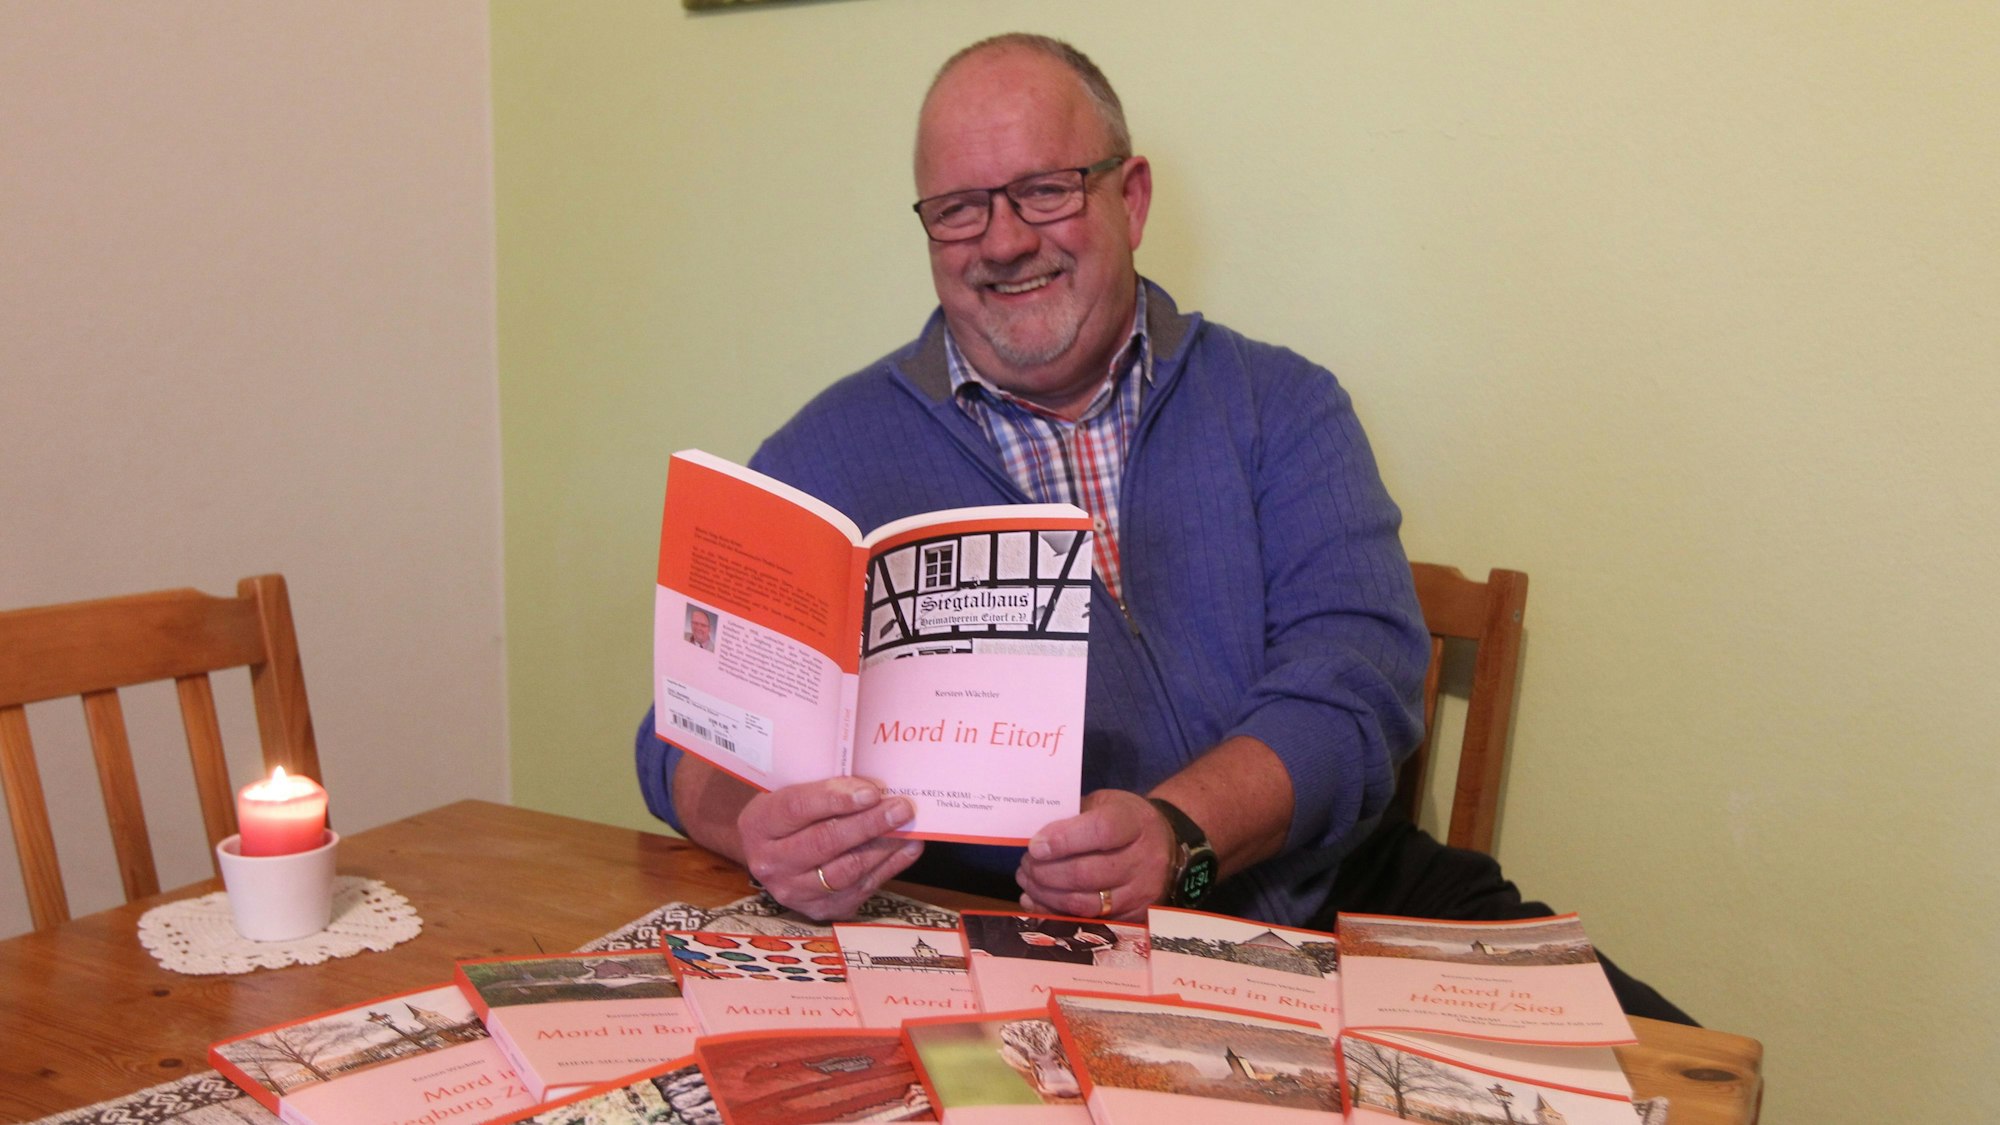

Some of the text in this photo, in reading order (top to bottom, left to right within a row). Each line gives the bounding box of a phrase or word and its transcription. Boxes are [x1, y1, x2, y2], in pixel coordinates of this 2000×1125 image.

[921, 592, 1029, 612] Siegtalhaus
[920, 615, 978, 627] Heimatverein
[981, 613, 1008, 622] Eitorf
[935, 689, 1000, 699] Kersten Wächtler
[873, 719, 946, 745] Mord
[954, 720, 978, 744] in
[989, 721, 1067, 757] Eitorf
[880, 787, 945, 799] EIN-SIEG-KREIS
[946, 790, 972, 800] KRIMI
[1172, 977, 1237, 996] Mord
[1247, 989, 1267, 1001] in
[1433, 983, 1532, 999] Mord in
[884, 994, 952, 1008] Mord
[1410, 993, 1564, 1016] Hennef/Sieg
[725, 1004, 791, 1017] Mord
[801, 1005, 822, 1017] in
[537, 1026, 609, 1041] Mord
[619, 1025, 643, 1036] in
[422, 1074, 493, 1103] Mord
